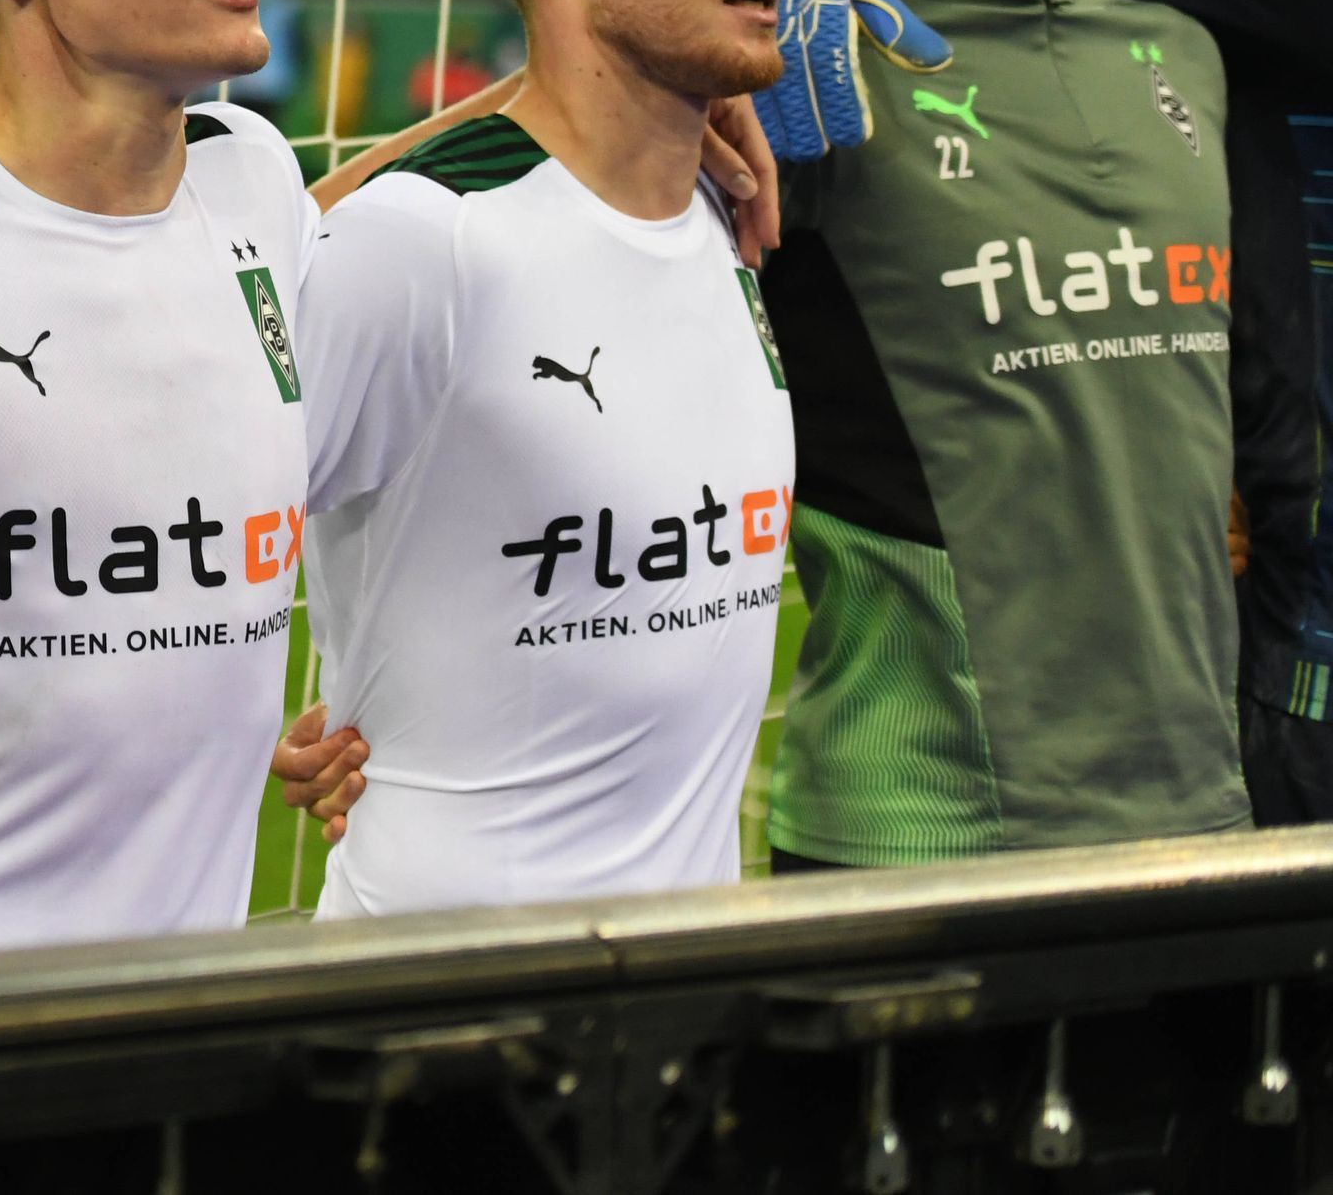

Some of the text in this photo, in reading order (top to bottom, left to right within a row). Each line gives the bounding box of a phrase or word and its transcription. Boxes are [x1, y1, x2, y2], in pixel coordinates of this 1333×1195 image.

[934, 135, 974, 180] 22
[992, 345, 1083, 374] AKTIEN.
[1087, 334, 1167, 361] ONLINE.
[126, 623, 235, 653] ONLINE.
[514, 616, 637, 647] AKTIEN.
[648, 598, 730, 634] ONLINE.
